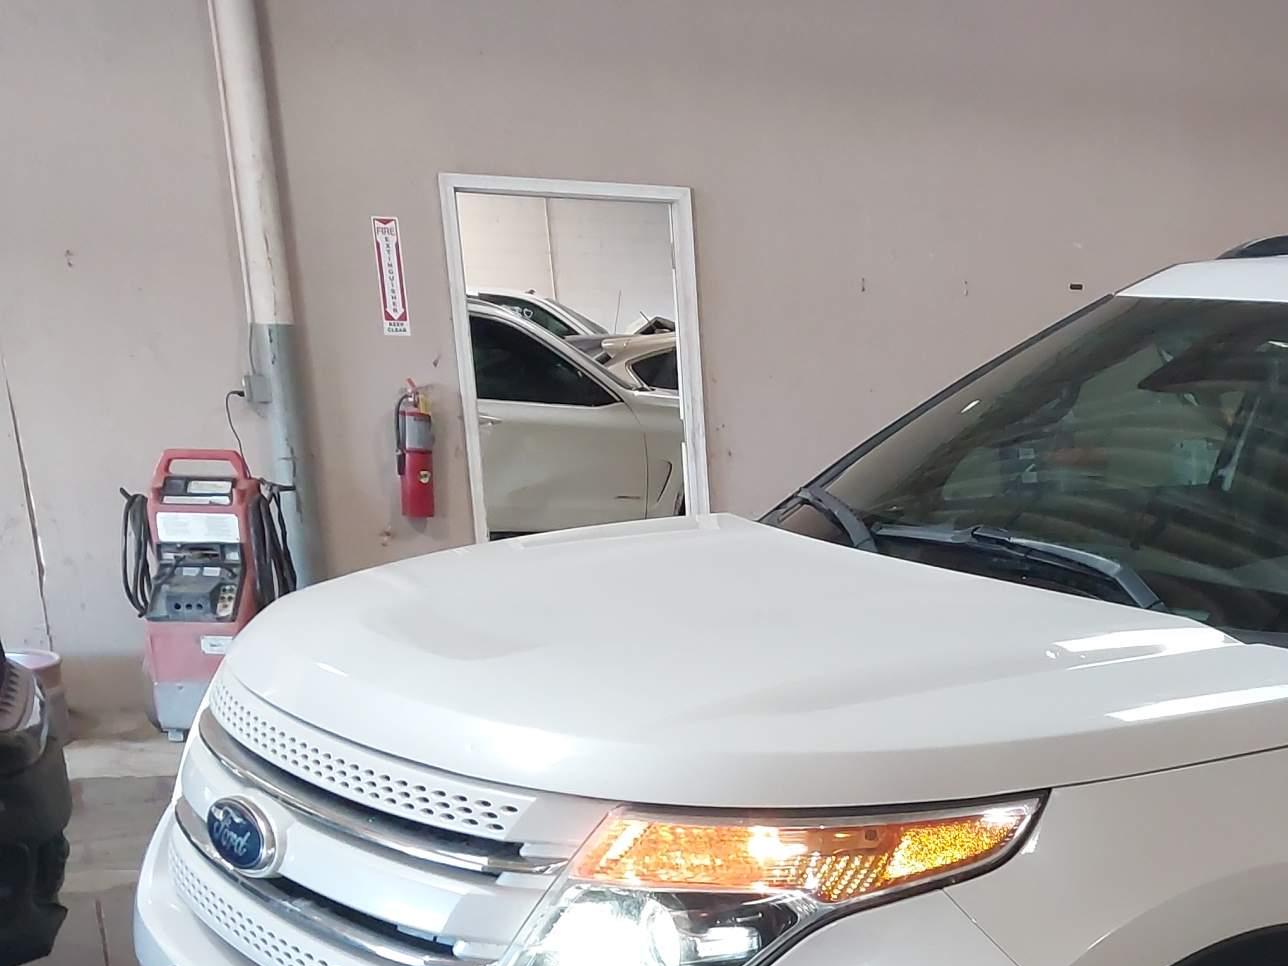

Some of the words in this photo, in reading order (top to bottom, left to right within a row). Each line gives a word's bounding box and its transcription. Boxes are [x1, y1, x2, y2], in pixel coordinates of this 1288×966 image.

[376, 226, 396, 236] FIRE
[384, 236, 398, 313] EXTINGUISHER
[212, 806, 251, 857] Ford
